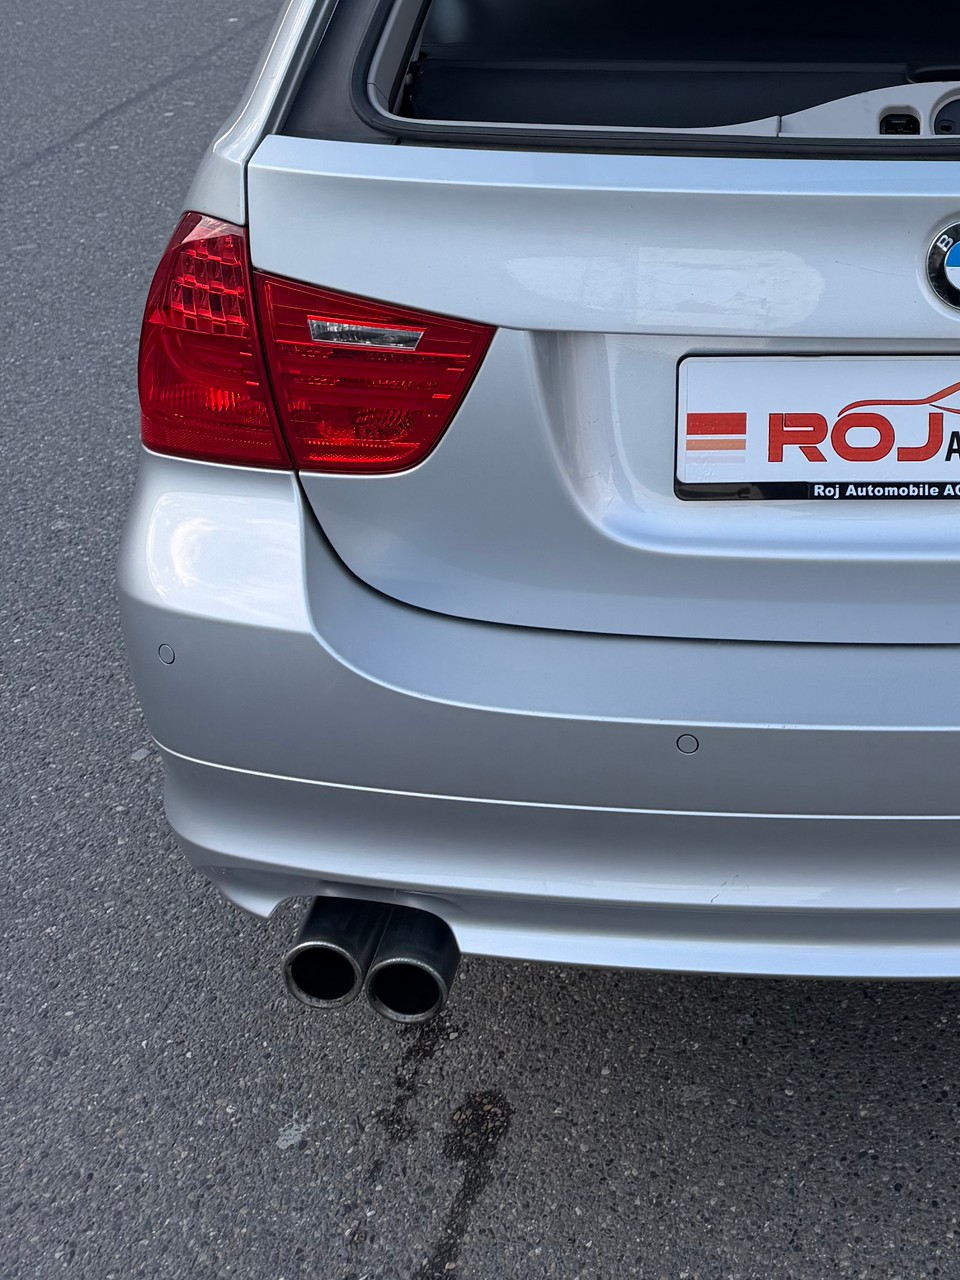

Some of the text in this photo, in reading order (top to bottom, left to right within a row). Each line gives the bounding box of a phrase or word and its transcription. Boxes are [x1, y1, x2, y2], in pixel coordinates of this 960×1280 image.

[767, 412, 944, 463] ROJ
[814, 484, 840, 499] Roj
[845, 484, 940, 496] Automobile
